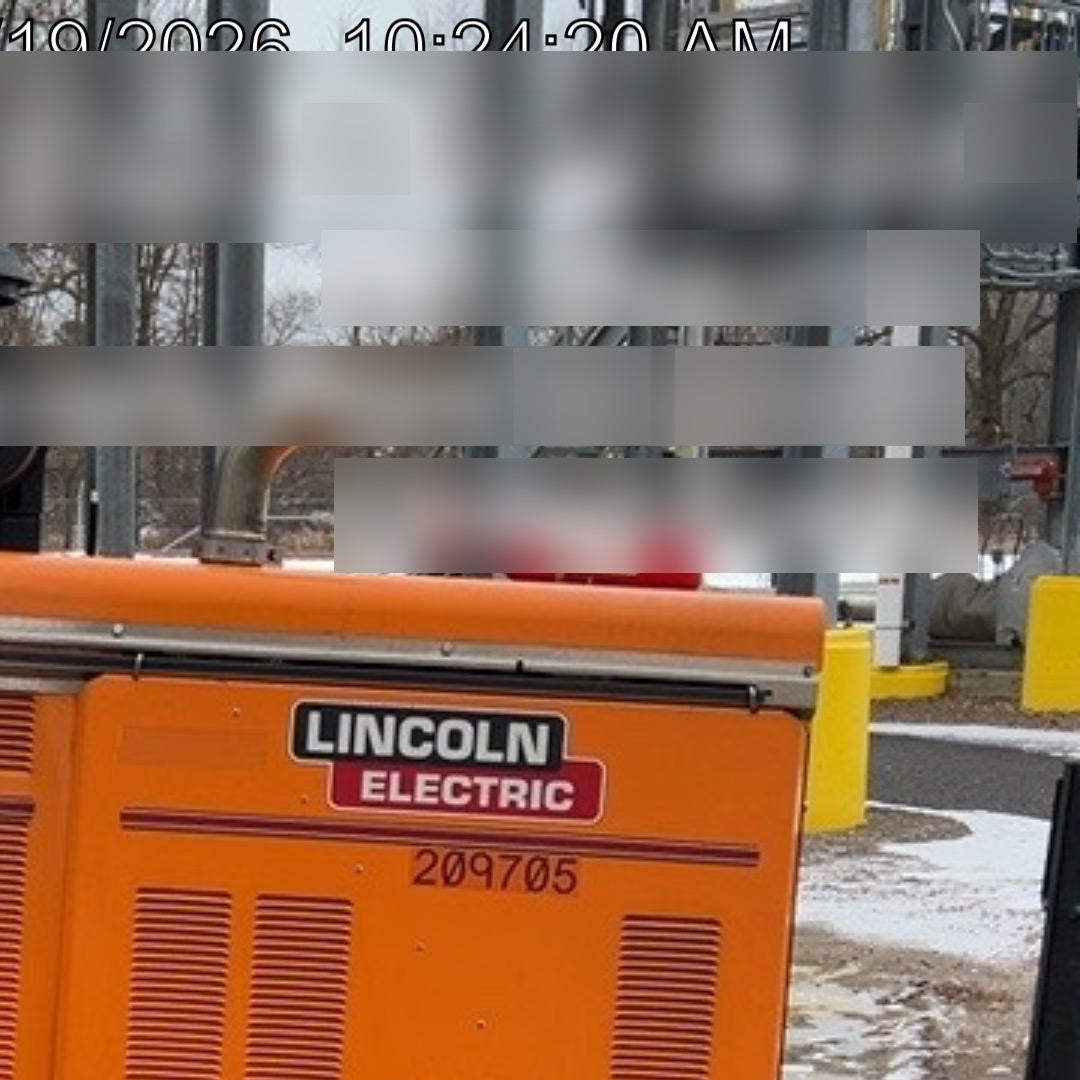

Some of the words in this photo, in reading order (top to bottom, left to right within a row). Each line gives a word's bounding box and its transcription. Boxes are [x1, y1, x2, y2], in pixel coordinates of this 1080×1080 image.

[305, 710, 551, 766] LINCOLN
[360, 769, 575, 812] ELECTRIC
[411, 848, 579, 895] 209705
